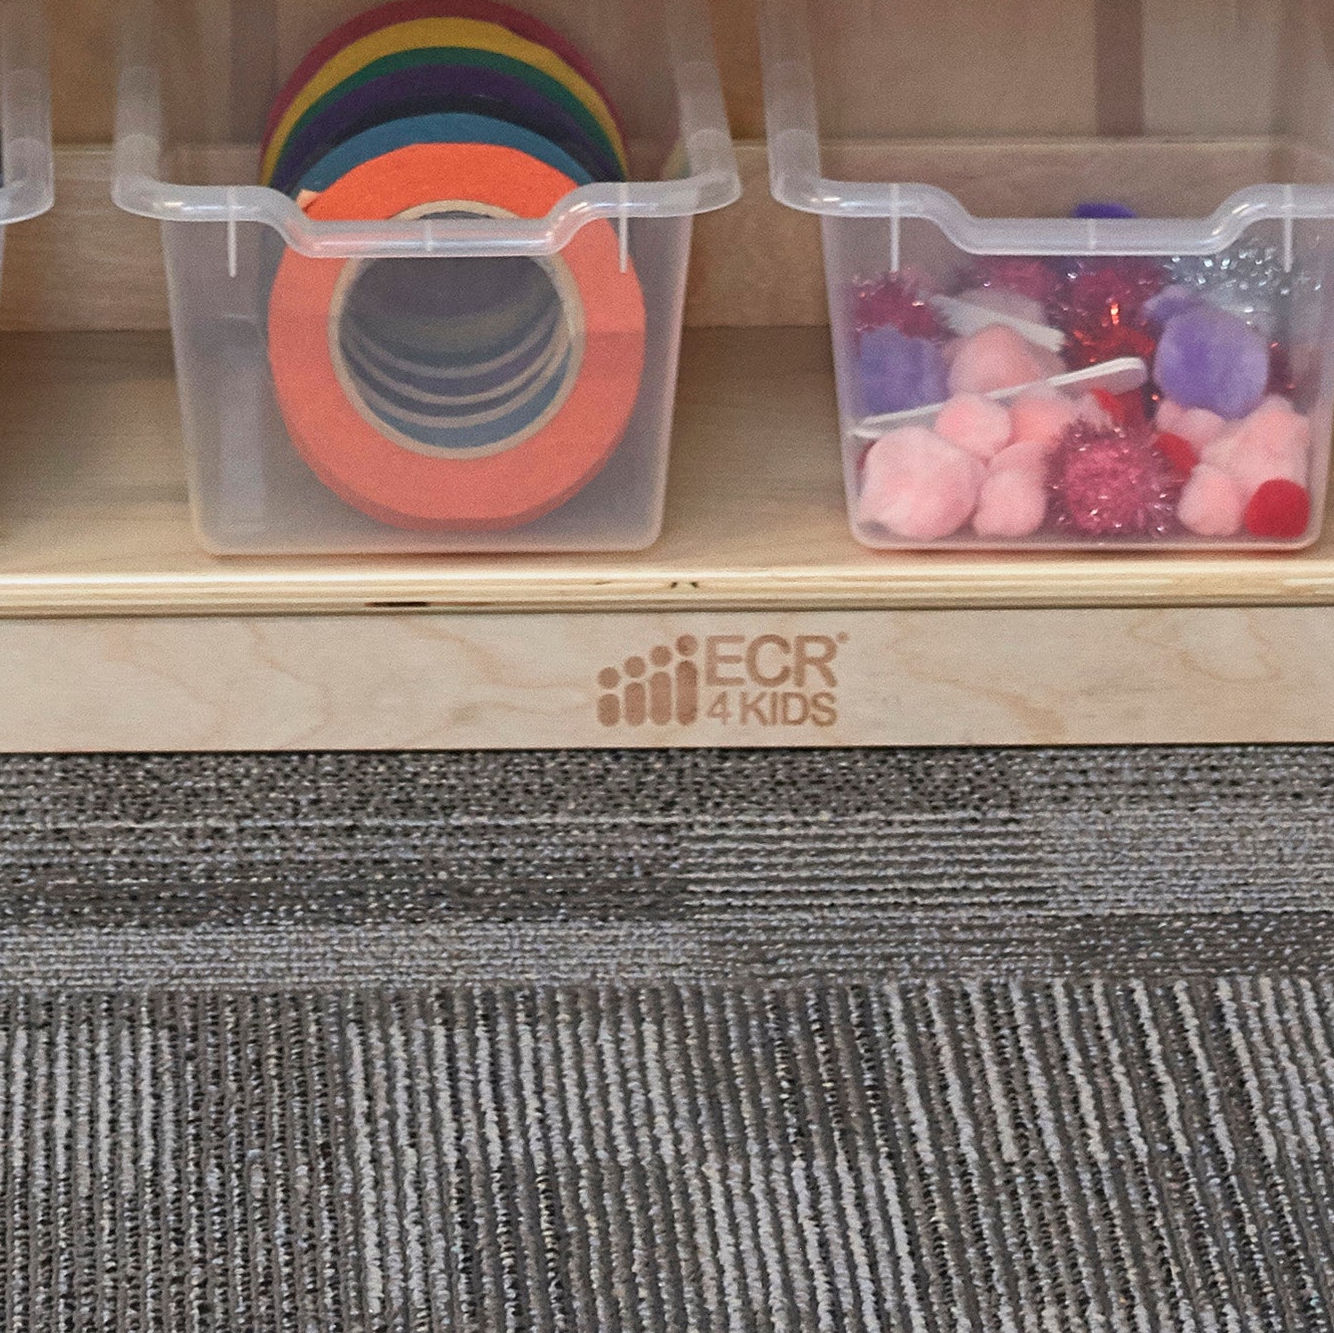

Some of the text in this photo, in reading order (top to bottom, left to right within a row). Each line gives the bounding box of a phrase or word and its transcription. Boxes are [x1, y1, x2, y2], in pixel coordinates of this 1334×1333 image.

[705, 633, 838, 688] ECR
[705, 690, 838, 728] 4 KIDS
